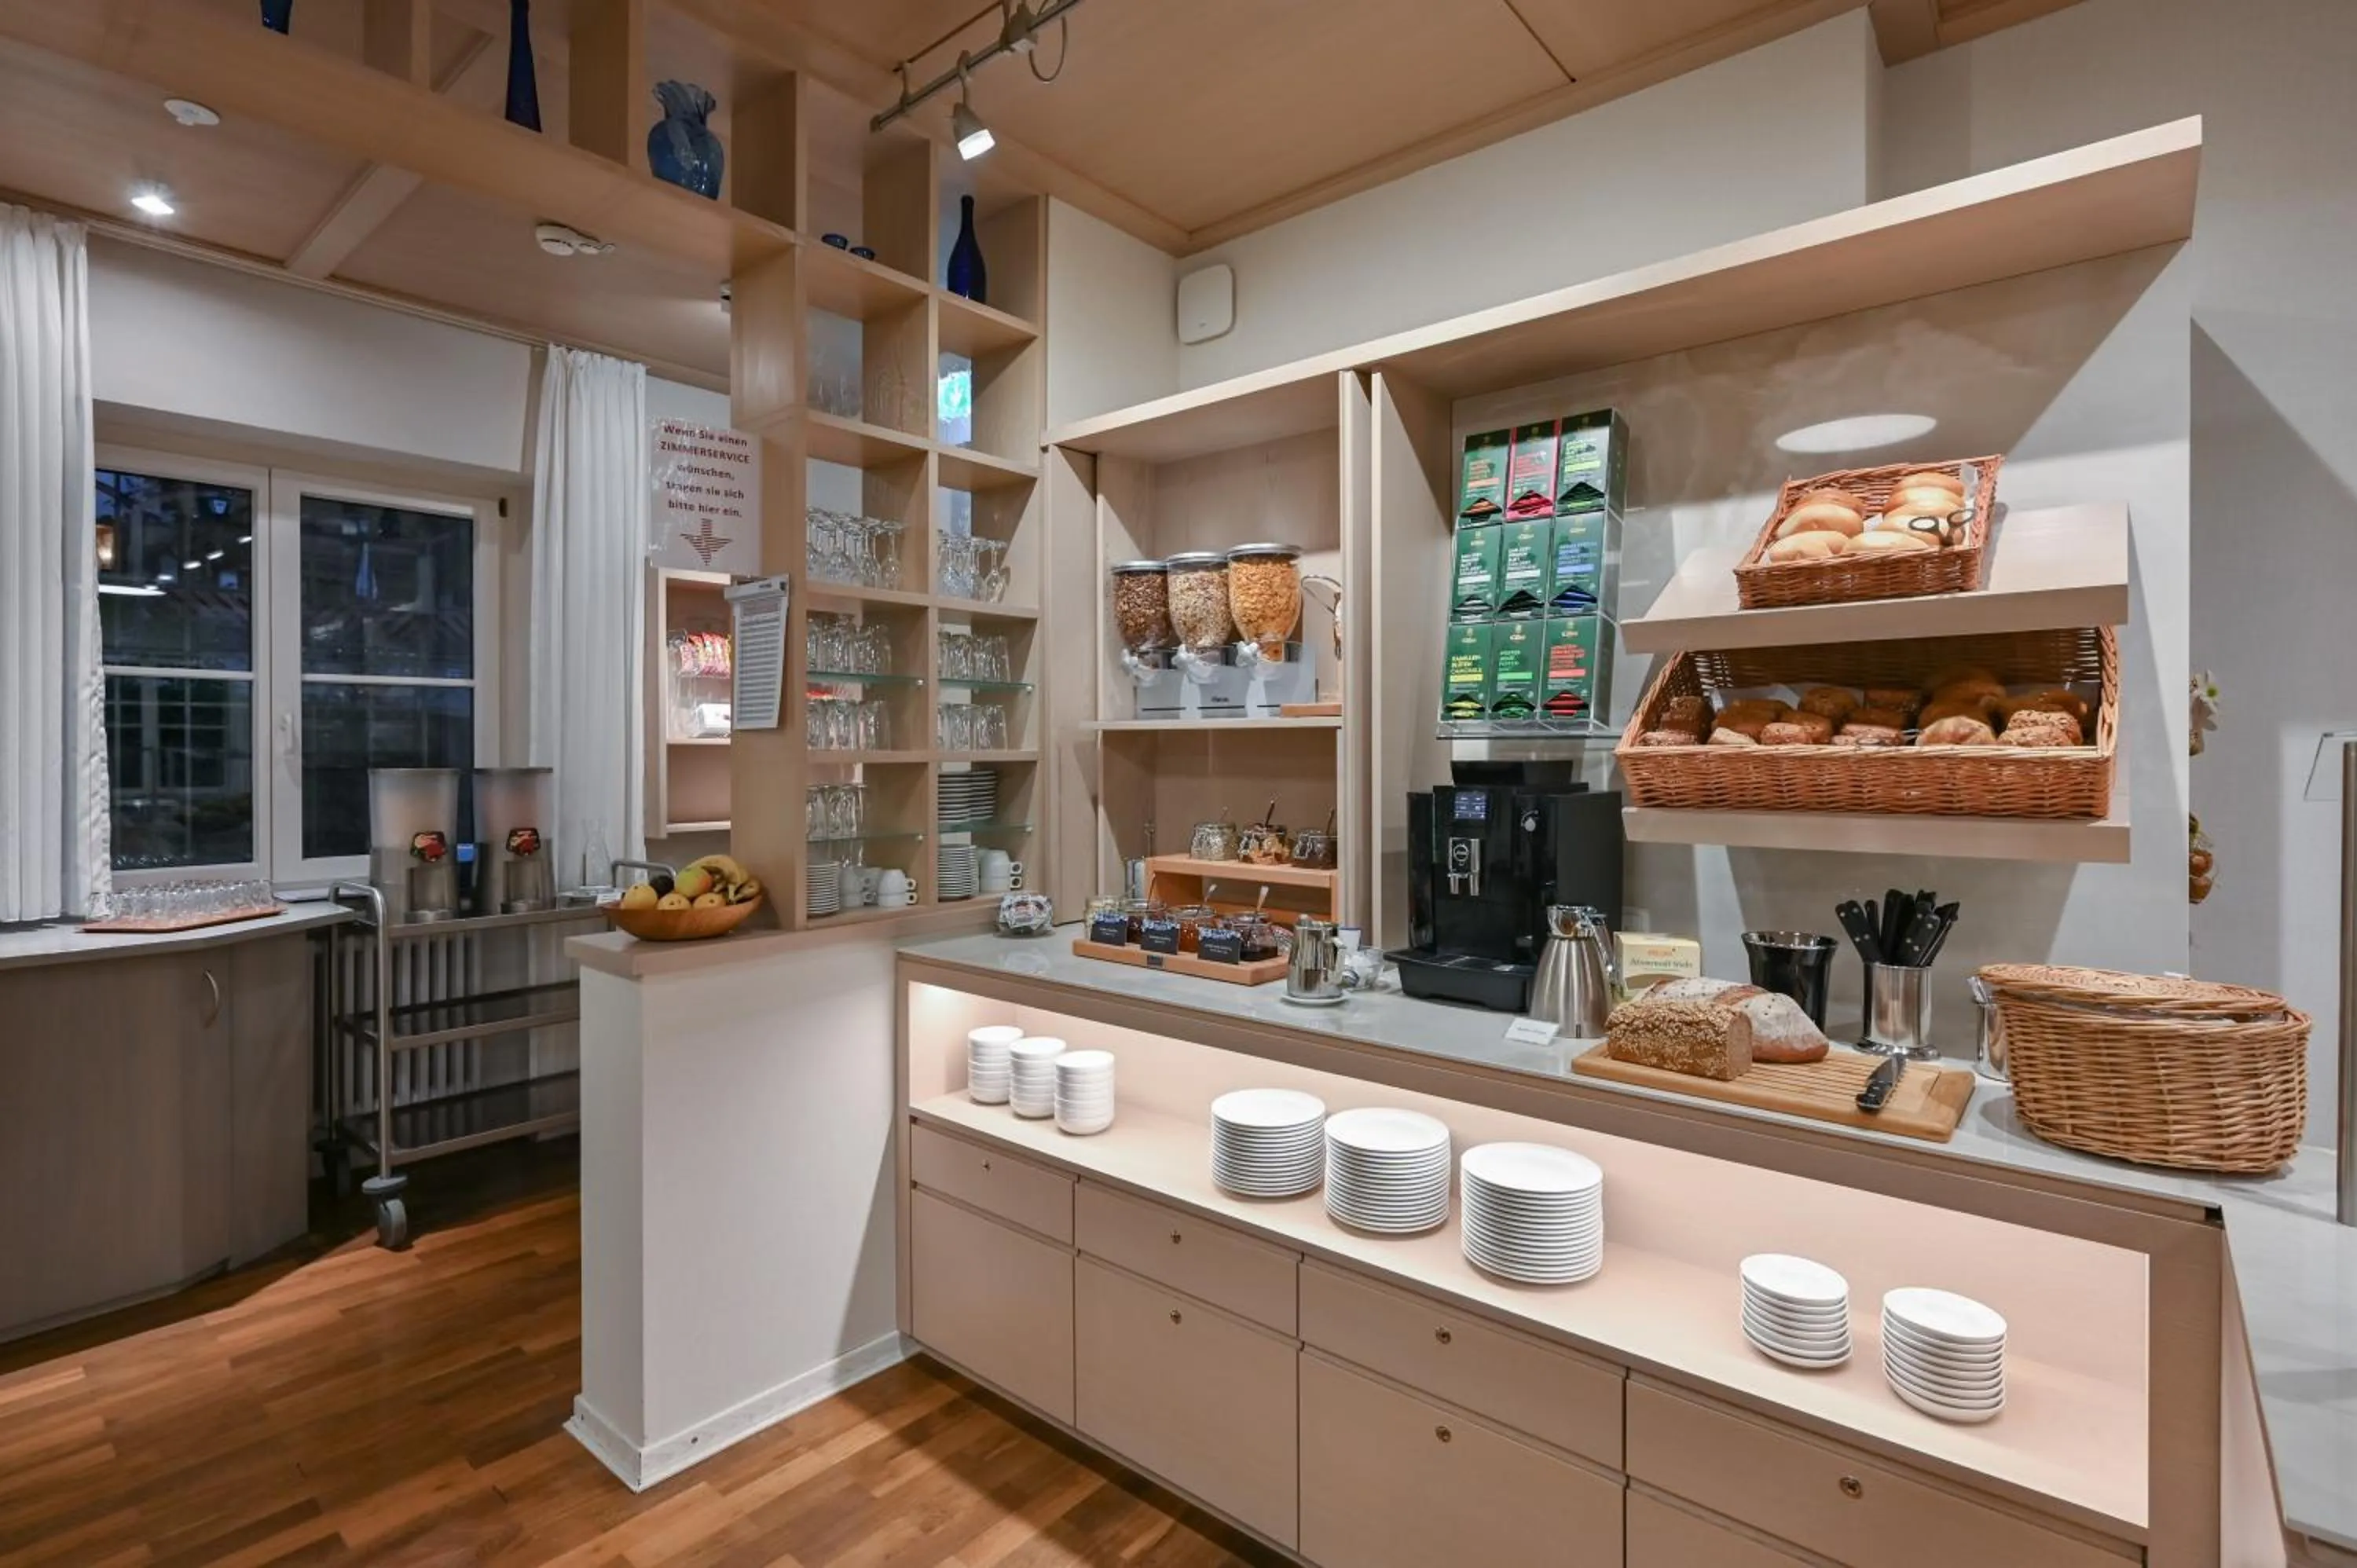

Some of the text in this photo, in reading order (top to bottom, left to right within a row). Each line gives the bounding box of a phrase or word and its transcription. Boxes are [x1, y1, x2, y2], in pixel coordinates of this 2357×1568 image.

[664, 424, 747, 446] Wenn Sie einen
[660, 441, 750, 463] ZIMMERSERVICE
[676, 464, 735, 481] wünschen,
[666, 481, 702, 494] tragen
[724, 489, 744, 500] sich
[669, 500, 742, 518] bitte hier ein.
